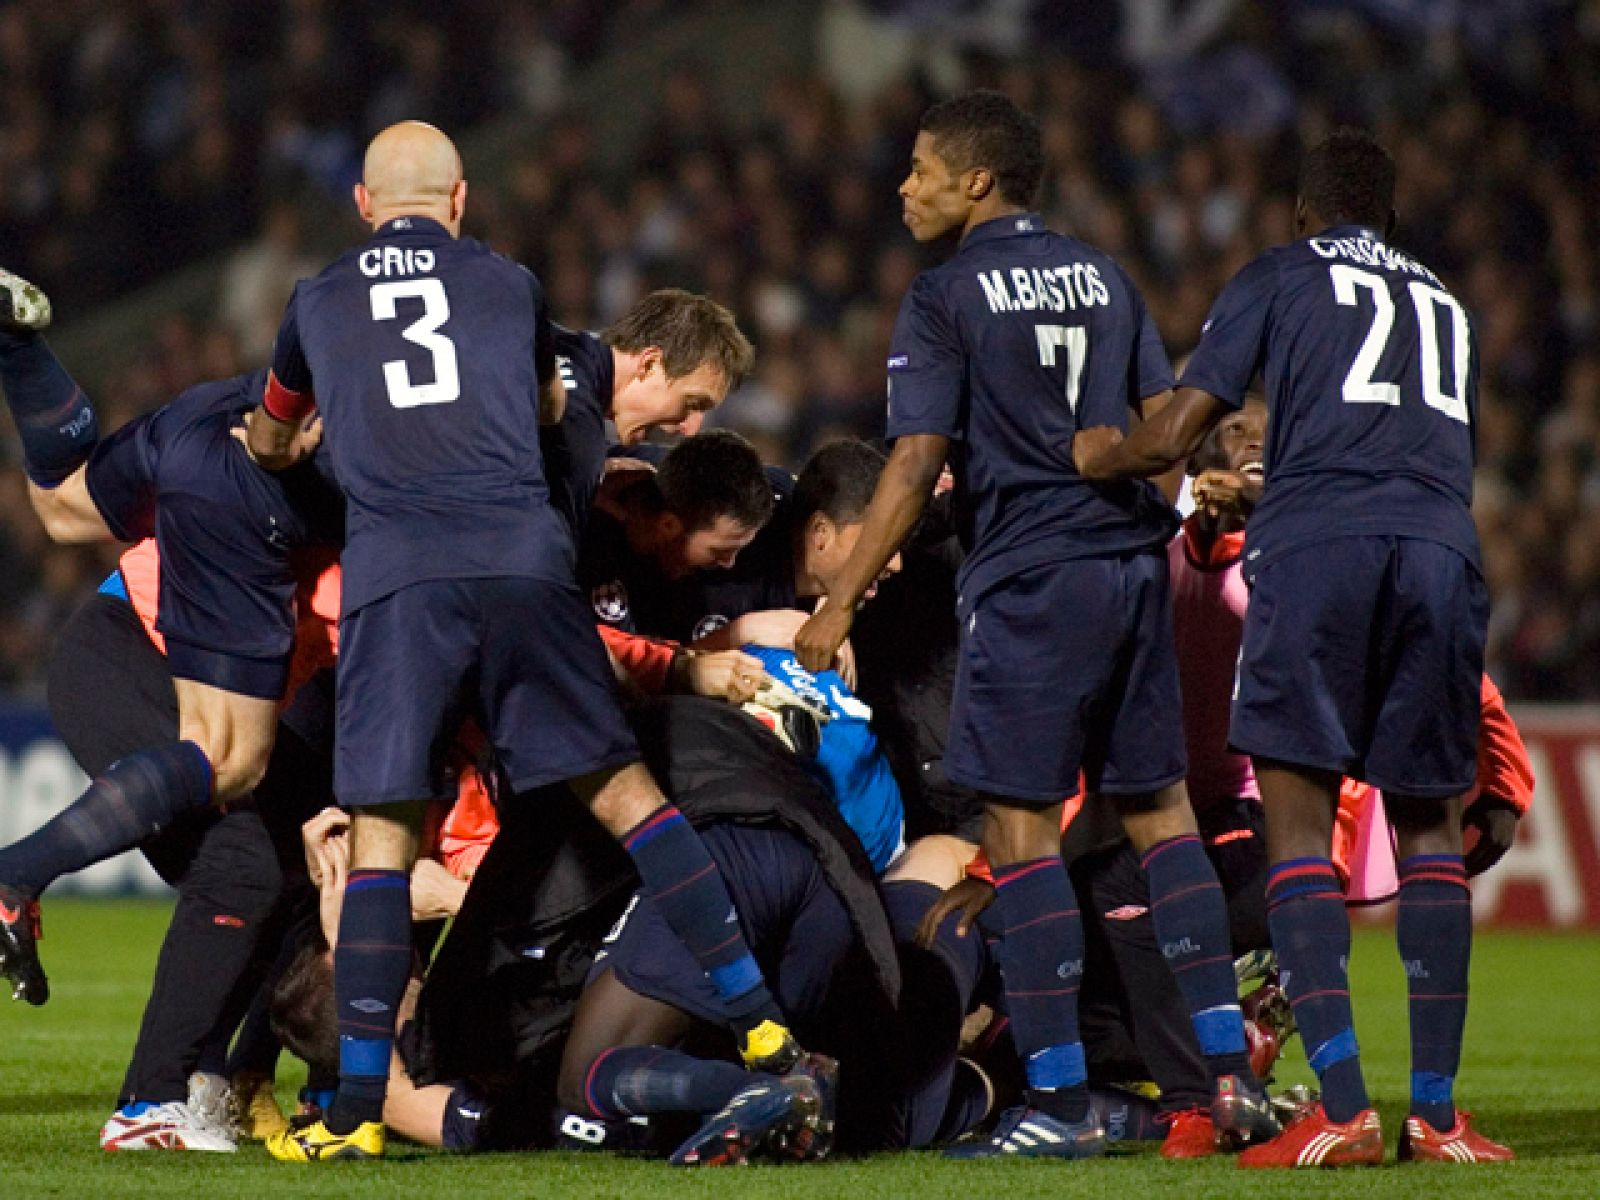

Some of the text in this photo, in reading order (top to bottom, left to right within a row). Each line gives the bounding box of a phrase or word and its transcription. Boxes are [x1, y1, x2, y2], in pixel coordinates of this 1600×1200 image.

[359, 246, 435, 277] CRIS
[977, 262, 1110, 313] M.BASTOS
[370, 278, 460, 408] 3
[1035, 324, 1087, 416] 7
[1330, 264, 1471, 425] 20
[561, 1114, 606, 1144] 8
